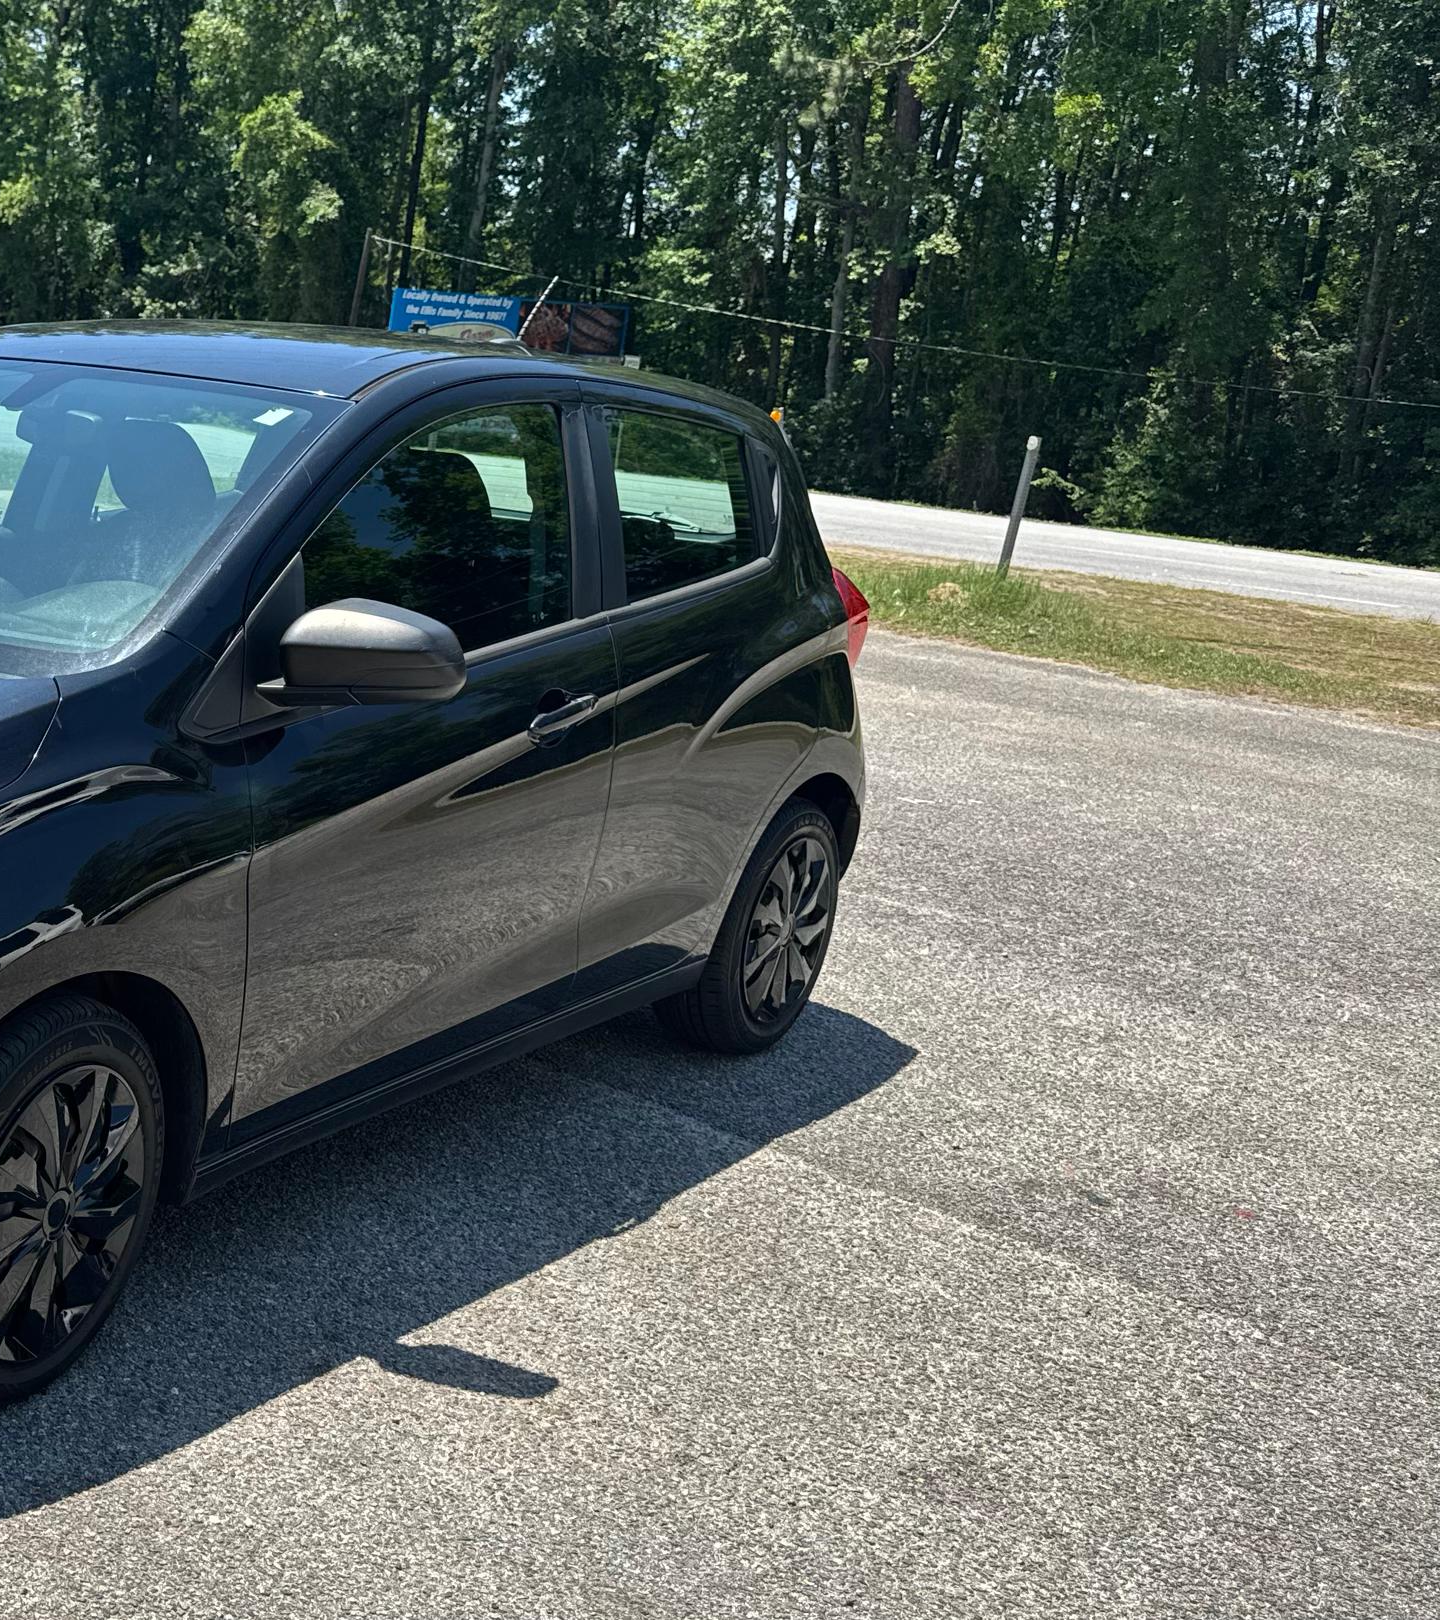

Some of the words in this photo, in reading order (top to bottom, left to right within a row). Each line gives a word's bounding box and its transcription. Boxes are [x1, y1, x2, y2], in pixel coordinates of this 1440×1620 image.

[402, 289, 430, 303] Locally
[431, 293, 458, 304] Owned
[459, 294, 465, 304] &
[467, 295, 502, 307] Operated
[503, 298, 513, 309] by
[406, 304, 419, 314] the
[437, 307, 463, 319] Family
[463, 309, 485, 320] Since
